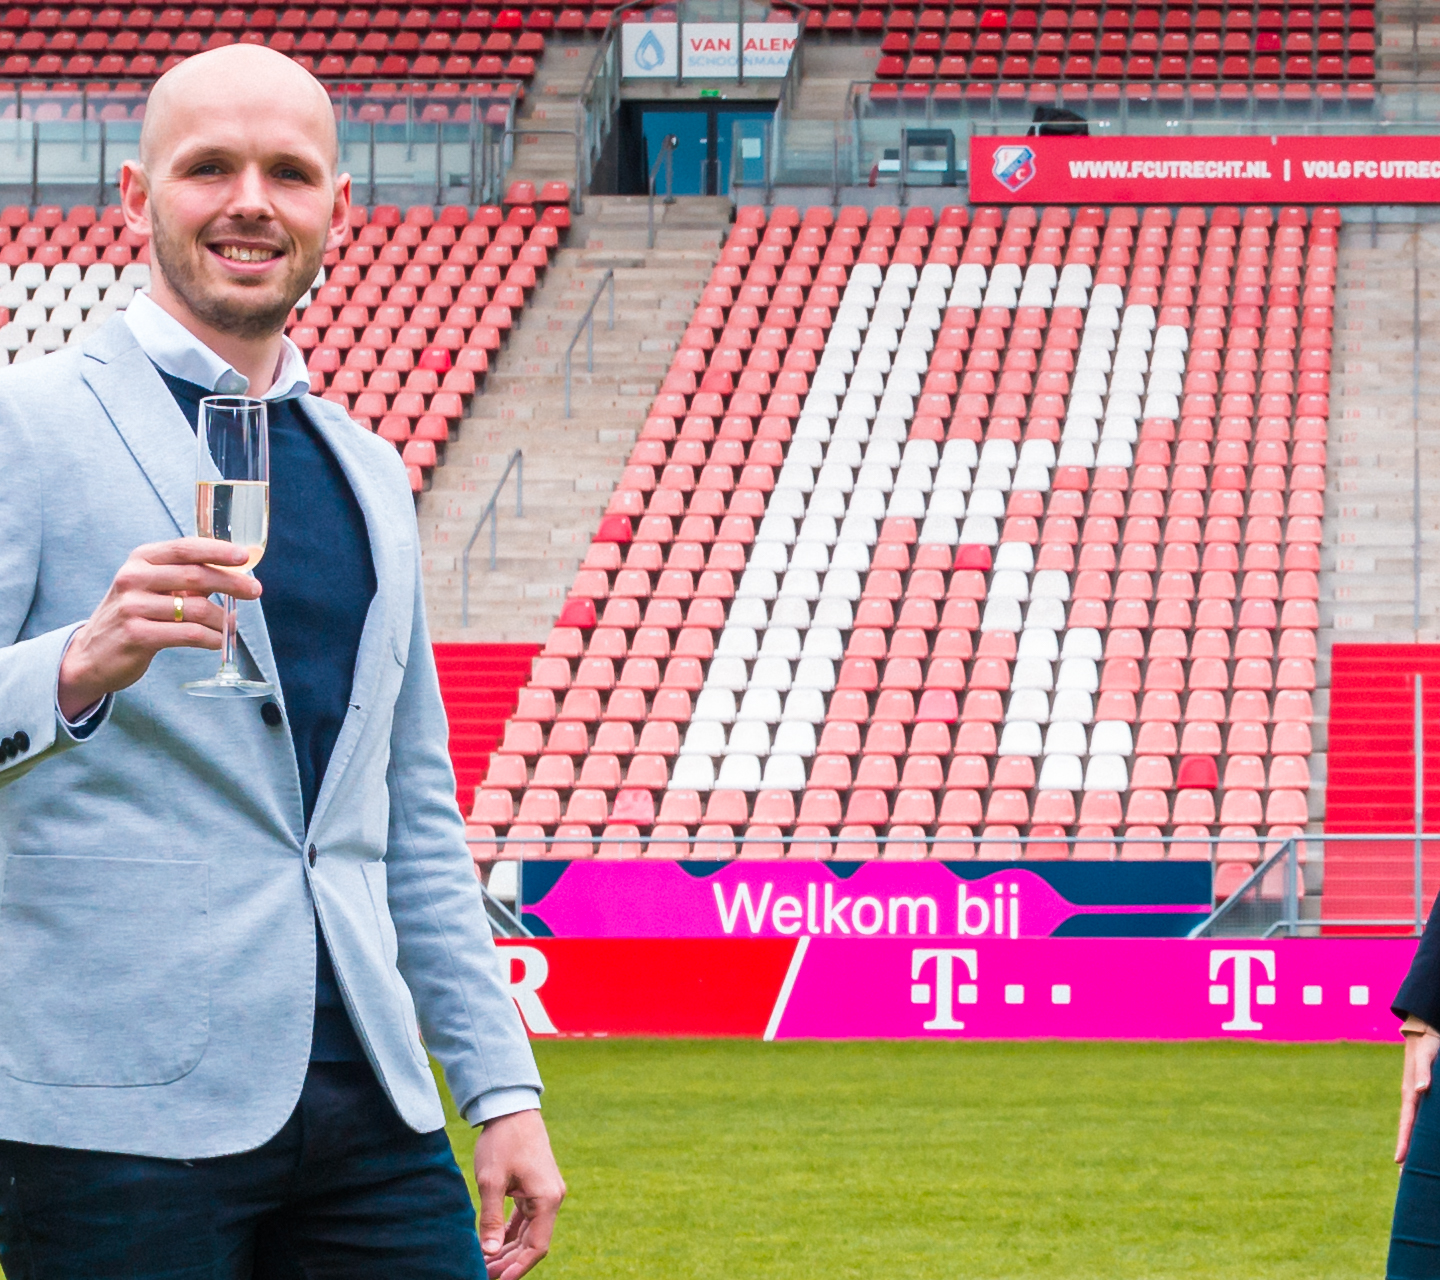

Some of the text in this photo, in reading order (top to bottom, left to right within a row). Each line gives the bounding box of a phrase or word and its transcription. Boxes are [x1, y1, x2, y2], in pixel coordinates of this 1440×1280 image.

[690, 38, 797, 51] VAN ALEM
[1068, 160, 1272, 179] WWW.FCUTRECHT.NL
[1302, 160, 1351, 179] VOLG
[1353, 160, 1378, 179] FC
[711, 882, 1019, 939] Welkom bij
[911, 948, 978, 1031] T
[1209, 949, 1276, 1031] T
